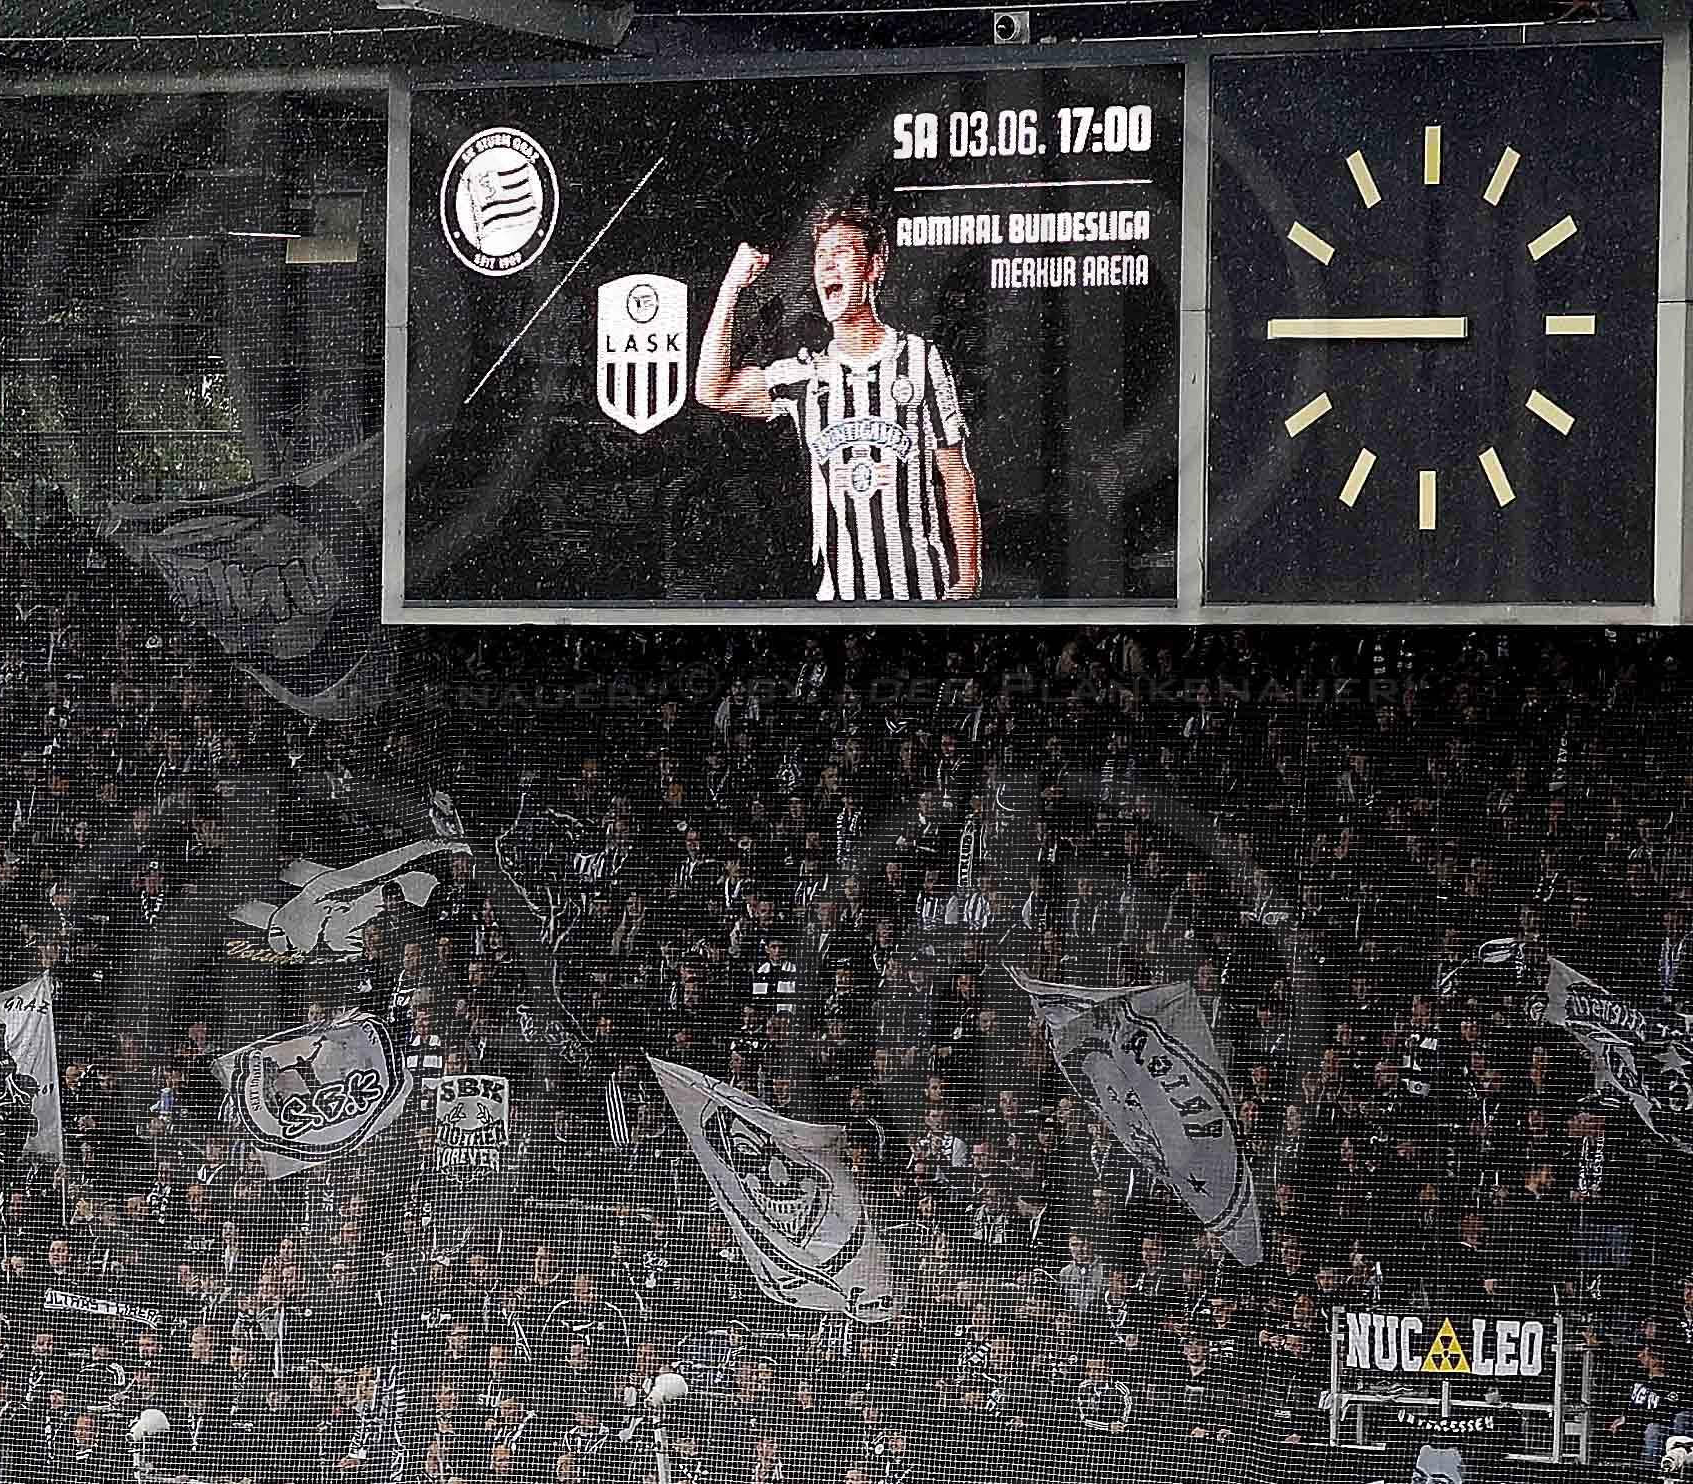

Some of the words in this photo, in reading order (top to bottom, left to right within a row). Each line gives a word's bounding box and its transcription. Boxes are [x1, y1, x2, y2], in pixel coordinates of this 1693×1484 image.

[893, 113, 939, 160] SA
[949, 110, 1047, 158] 03.06.
[1057, 105, 1152, 154] 17:00
[896, 213, 1004, 247] ADMIRAL
[1008, 210, 1150, 244] BUNDESLIGA
[990, 255, 1077, 289] MERKUR
[1083, 254, 1149, 287] ARENA
[605, 332, 681, 353] LASK
